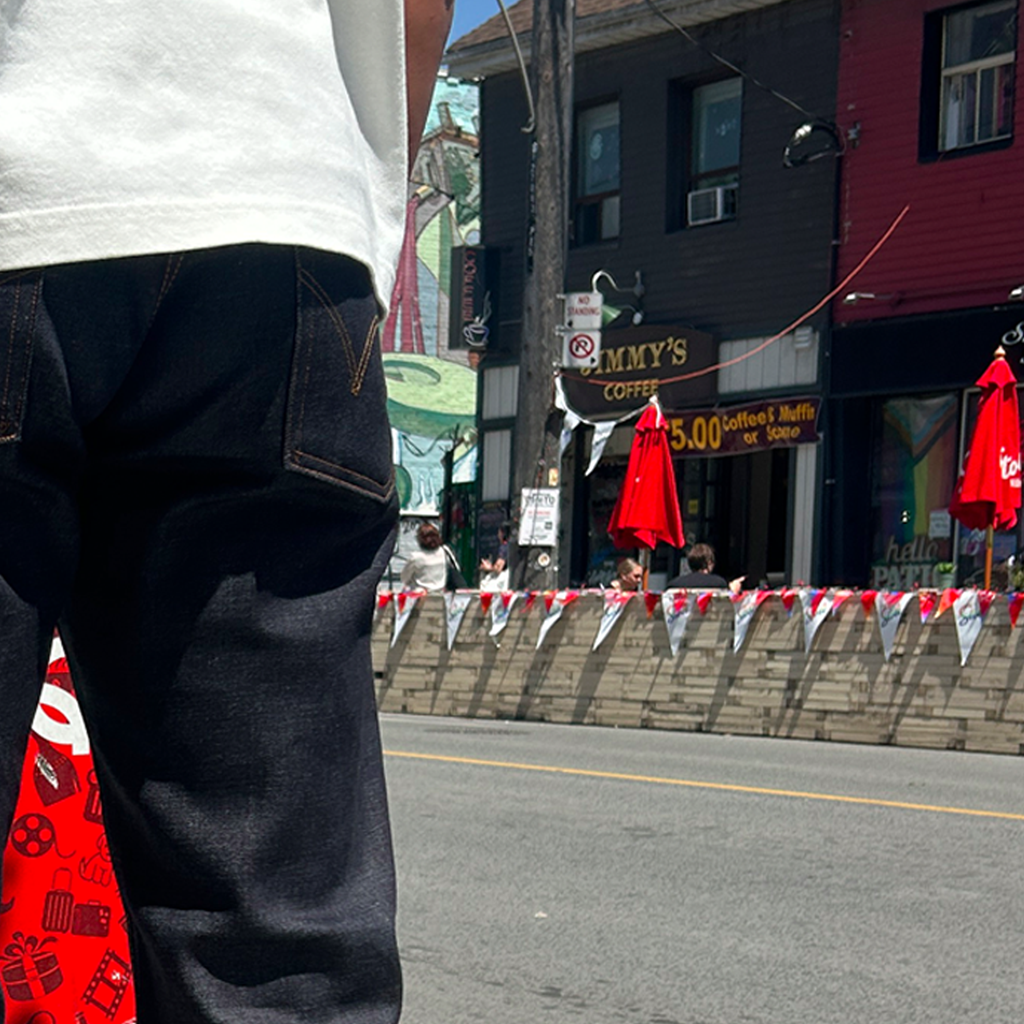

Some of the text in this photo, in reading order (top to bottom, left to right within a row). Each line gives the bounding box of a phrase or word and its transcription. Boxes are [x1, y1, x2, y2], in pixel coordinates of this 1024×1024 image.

[578, 295, 590, 305] NO
[579, 336, 688, 377] IMMY'S
[603, 378, 660, 401] COFFEE
[886, 535, 939, 562] hello
